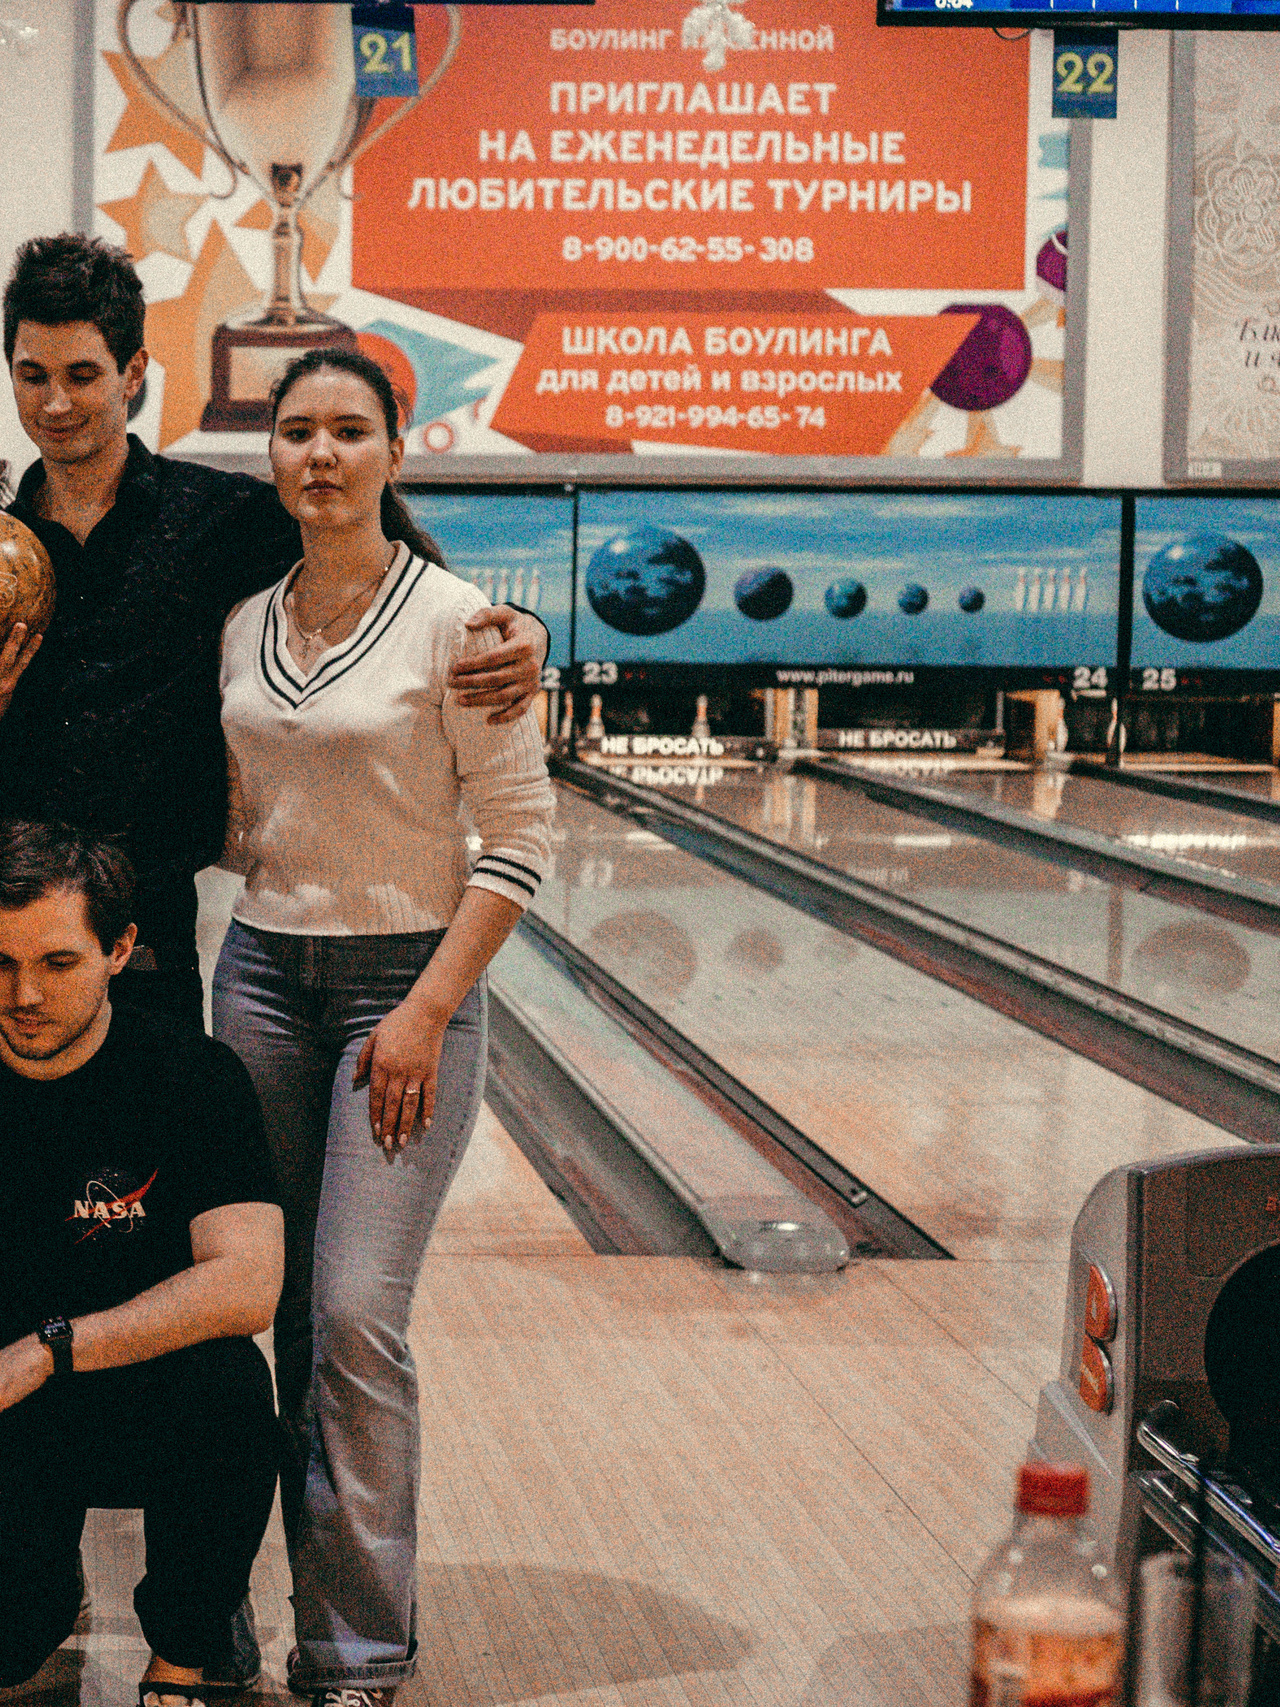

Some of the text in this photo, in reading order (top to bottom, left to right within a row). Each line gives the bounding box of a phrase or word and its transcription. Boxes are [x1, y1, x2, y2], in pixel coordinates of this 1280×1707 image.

[550, 28, 672, 51] БОУЛИНГ
[359, 32, 412, 73] 21
[1056, 52, 1114, 94] 22
[549, 82, 837, 115] ПРИГЛАШАЕТ
[479, 130, 905, 170] НА ЕЖЕНЕДЕЛЬНЫЕ
[407, 177, 971, 213] ЛЮБИТЕЛЬСКИЕ ТУРНИРЫ
[562, 327, 892, 356] ШКОЛА БОУЛИНГА
[536, 364, 903, 399] для детей и взрослых
[583, 661, 618, 685] 23
[776, 669, 914, 687] www.pitergame.ru
[1073, 666, 1108, 689] 24
[1142, 667, 1177, 691] 25
[601, 736, 724, 756] НЕ БРОСАТЬ
[838, 730, 958, 749] НЕ БРОСАТЬ
[73, 1199, 147, 1219] NASA
